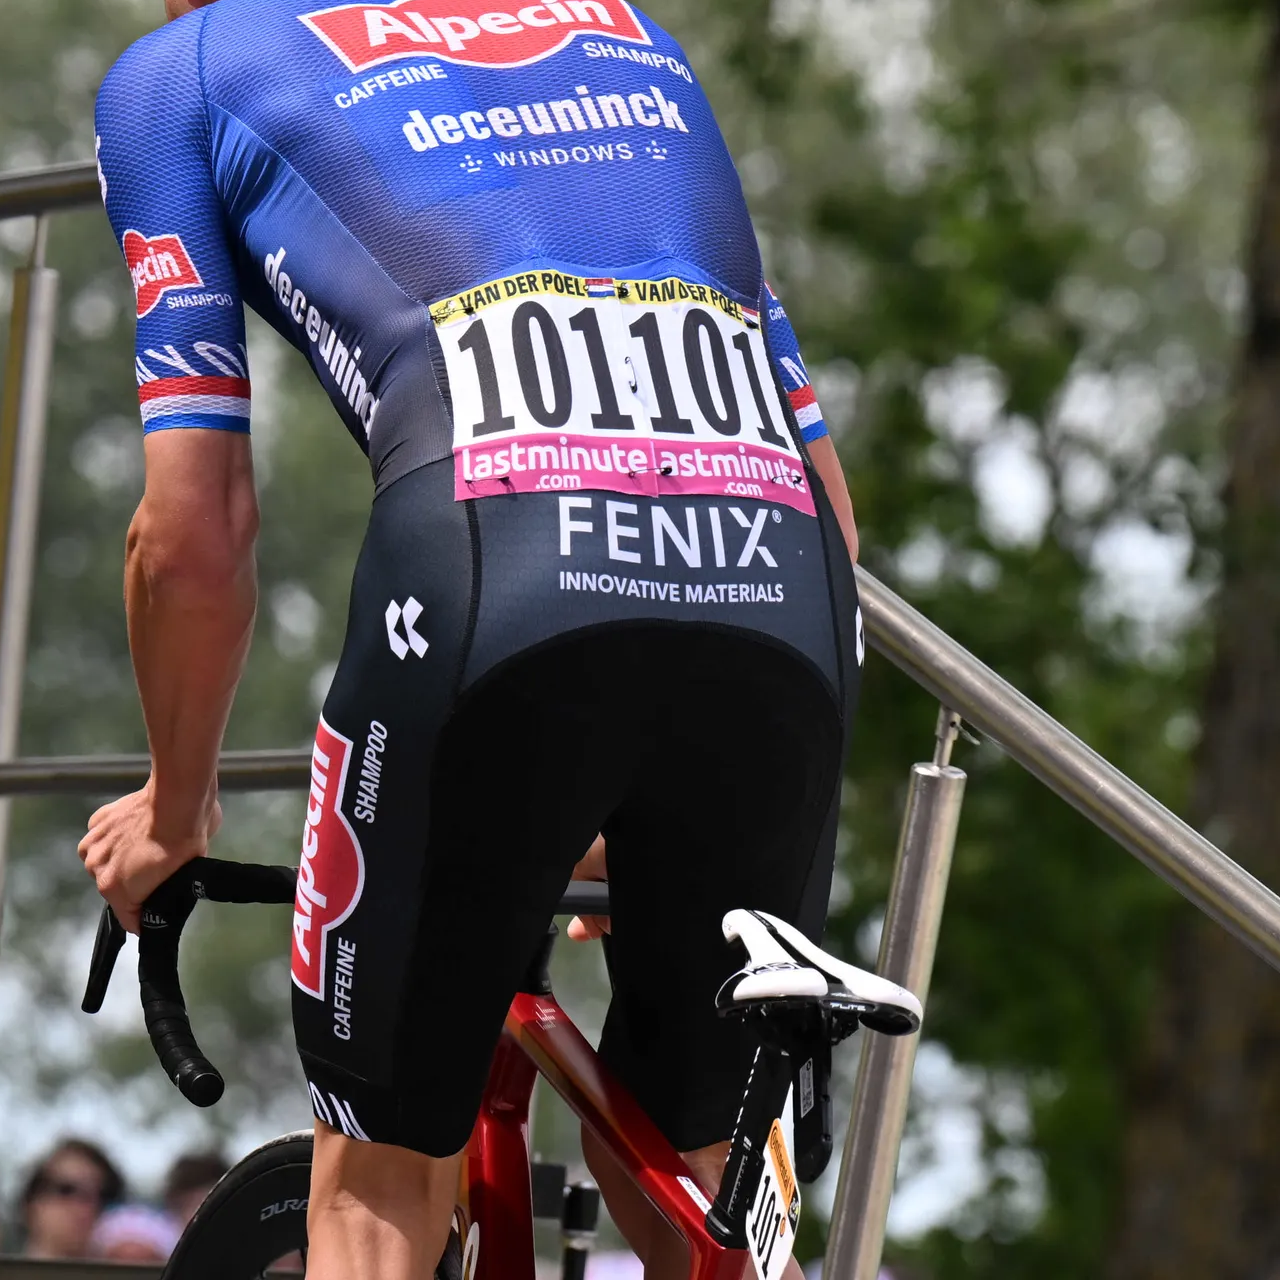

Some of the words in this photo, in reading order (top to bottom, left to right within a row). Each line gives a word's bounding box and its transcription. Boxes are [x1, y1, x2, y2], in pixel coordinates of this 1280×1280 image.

[582, 41, 693, 84] SHAMPOO
[334, 64, 448, 109] CAFFEINE
[402, 85, 690, 152] deceuninck
[493, 143, 635, 168] WINDOWS
[166, 293, 234, 310] SHAMPOO
[458, 283, 501, 309] VAN
[503, 273, 540, 297] DER
[541, 272, 586, 297] POEL
[634, 279, 676, 302] VAN
[678, 281, 709, 303] DER
[710, 288, 744, 321] POEL
[458, 301, 635, 438] 101
[628, 308, 788, 451] 101
[462, 436, 648, 480] lastminute
[656, 445, 807, 494] astminute
[535, 473, 581, 490] .com
[724, 480, 763, 497] .com
[560, 571, 681, 603] INNOVATIVE
[685, 583, 784, 604] MATERIALS
[354, 719, 388, 824] SHAMPOO
[292, 740, 331, 966] Alpecin
[334, 936, 357, 1041] CAFFEINE
[751, 1175, 781, 1280] 101
